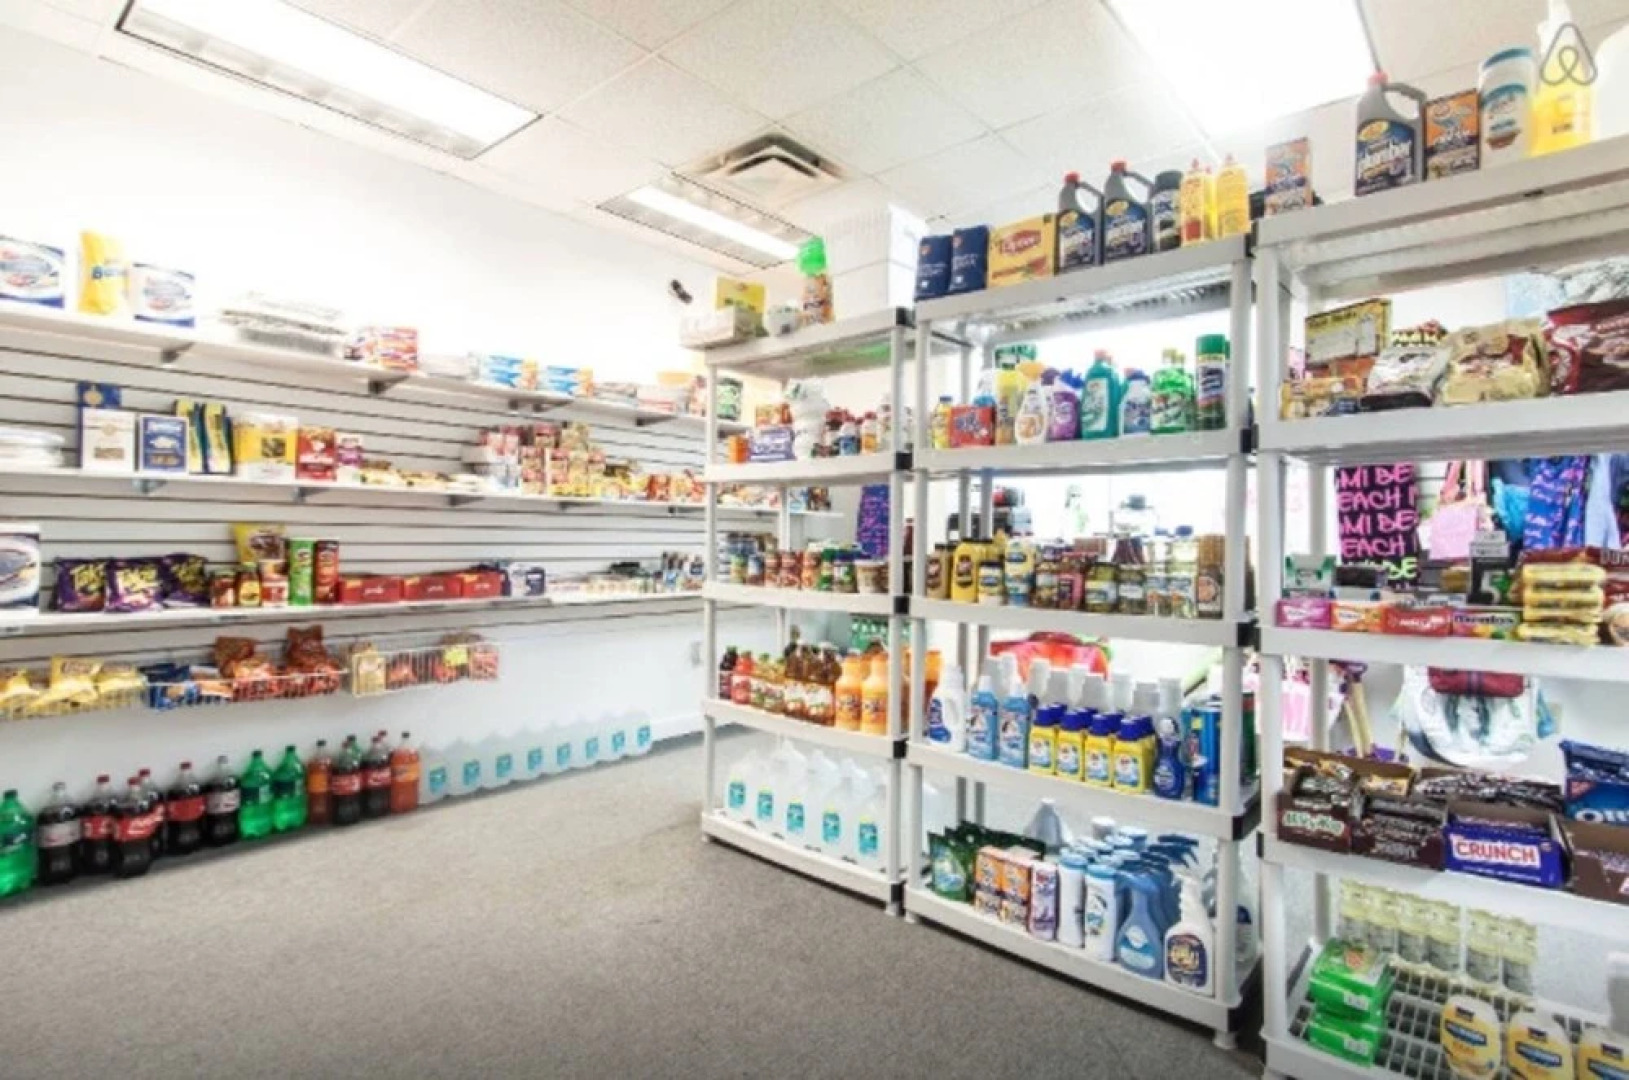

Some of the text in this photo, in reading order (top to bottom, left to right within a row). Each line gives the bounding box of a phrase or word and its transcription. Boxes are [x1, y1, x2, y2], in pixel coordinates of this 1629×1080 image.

[1337, 486, 1401, 512] EACH
[1341, 534, 1406, 558] EACH
[1455, 839, 1537, 864] CRUNCH
